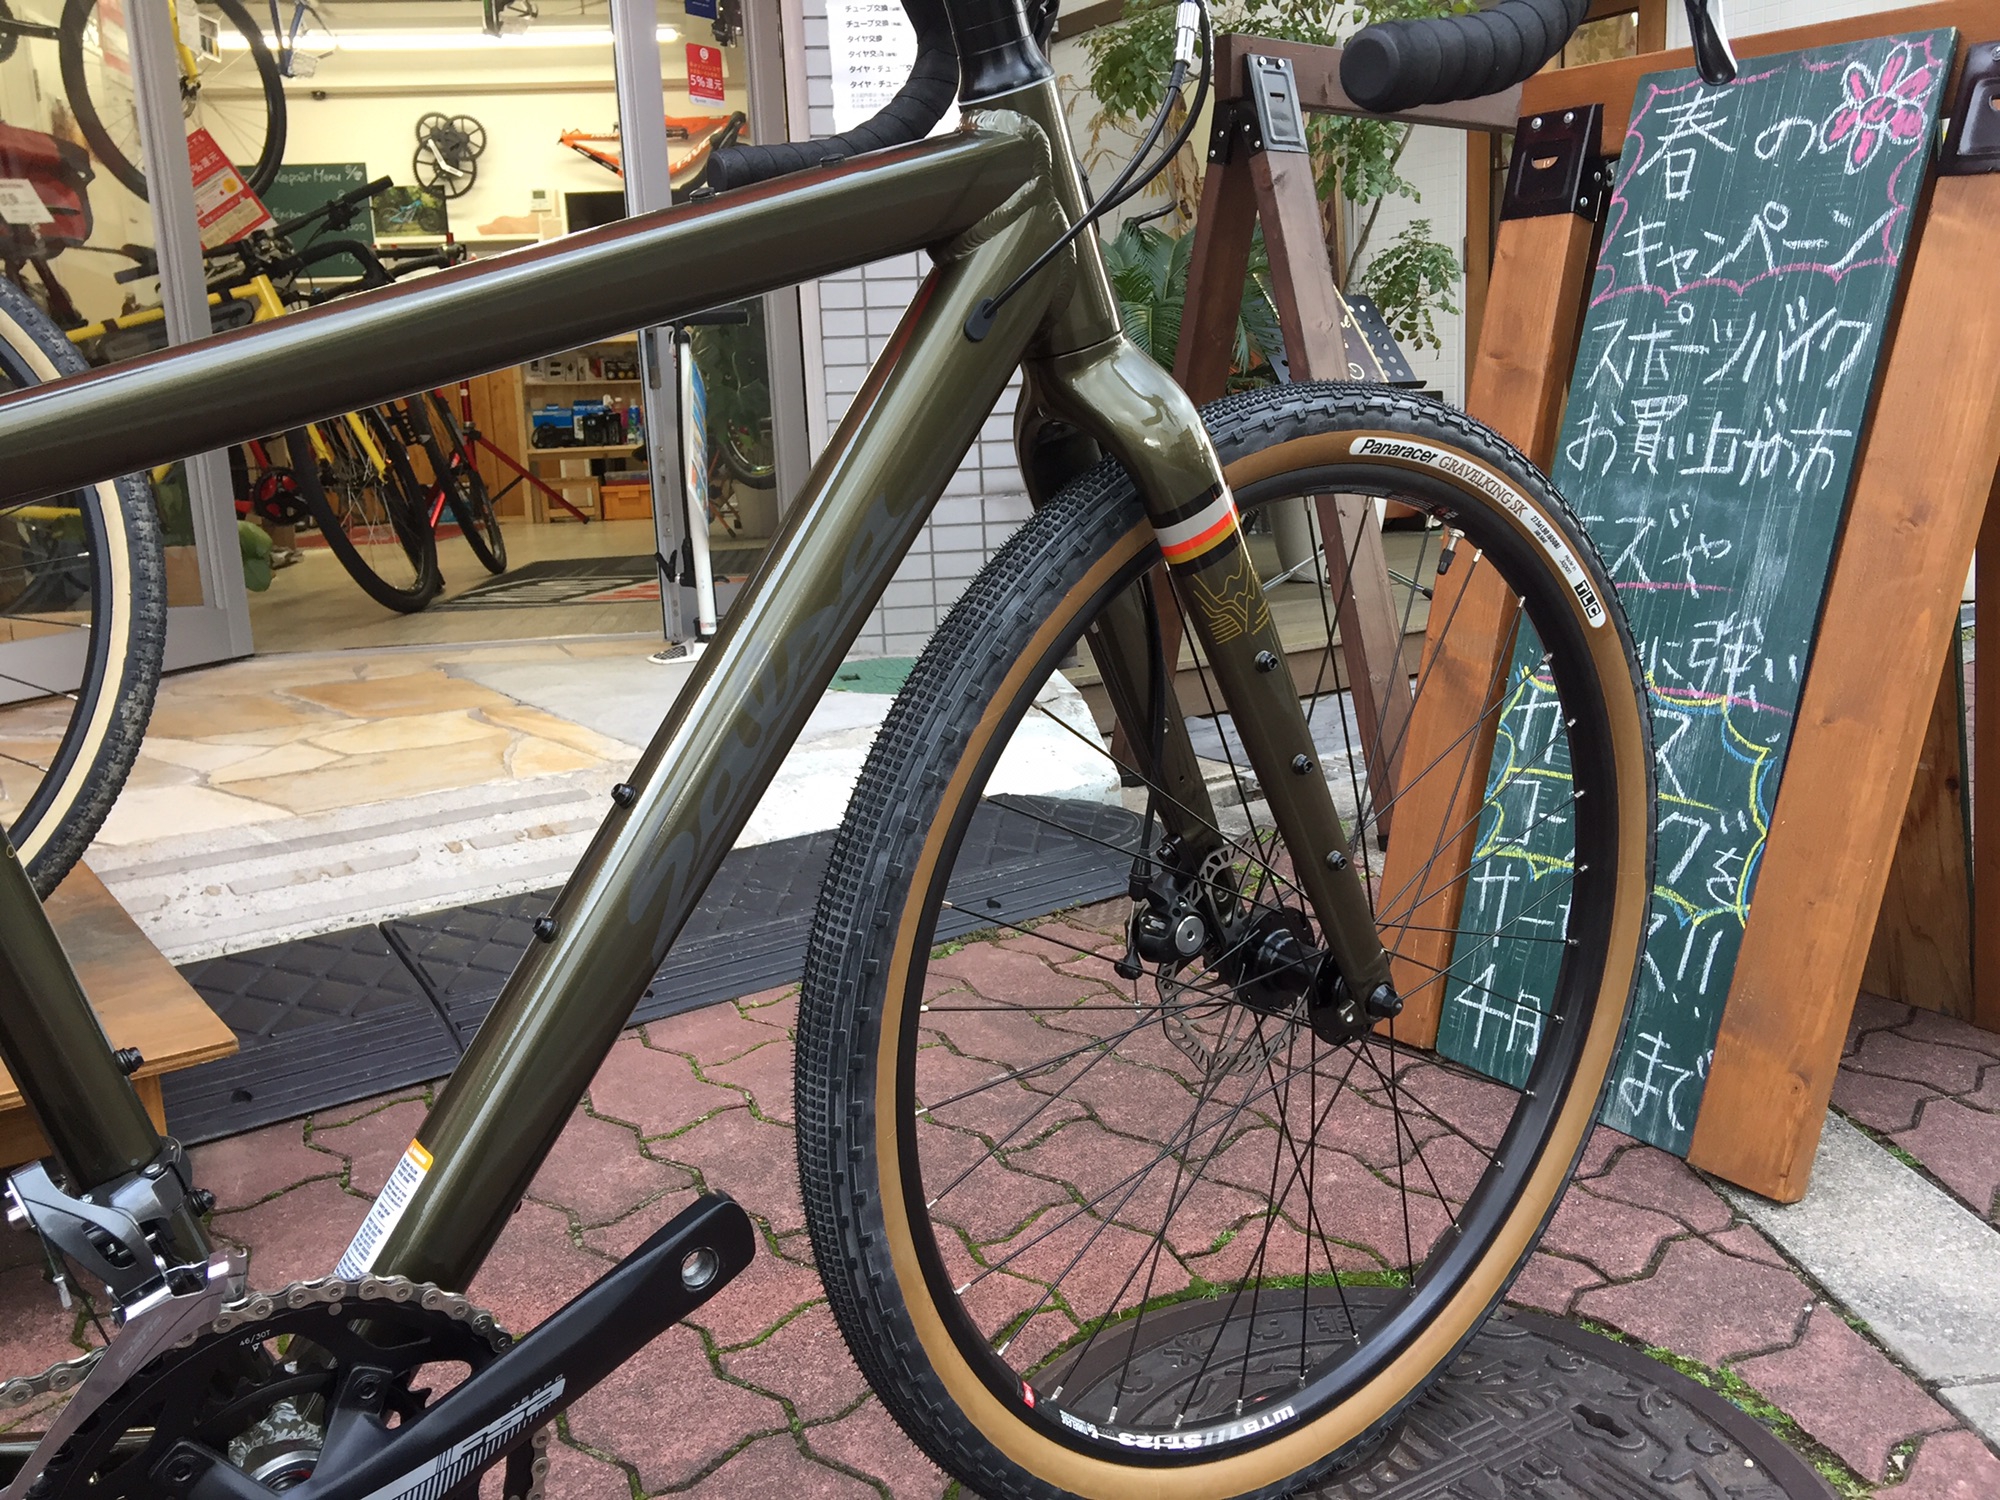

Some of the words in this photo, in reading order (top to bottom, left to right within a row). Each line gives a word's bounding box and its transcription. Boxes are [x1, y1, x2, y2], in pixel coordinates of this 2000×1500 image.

[1623, 201, 1899, 293] キャンペーン
[1358, 439, 1438, 465] Panaracer
[1438, 455, 1516, 506] GRAVELKING
[1508, 499, 1529, 518] SK
[1574, 579, 1602, 619] TLC
[239, 1329, 271, 1347] 46/30T
[1243, 1405, 1296, 1435] WTB
